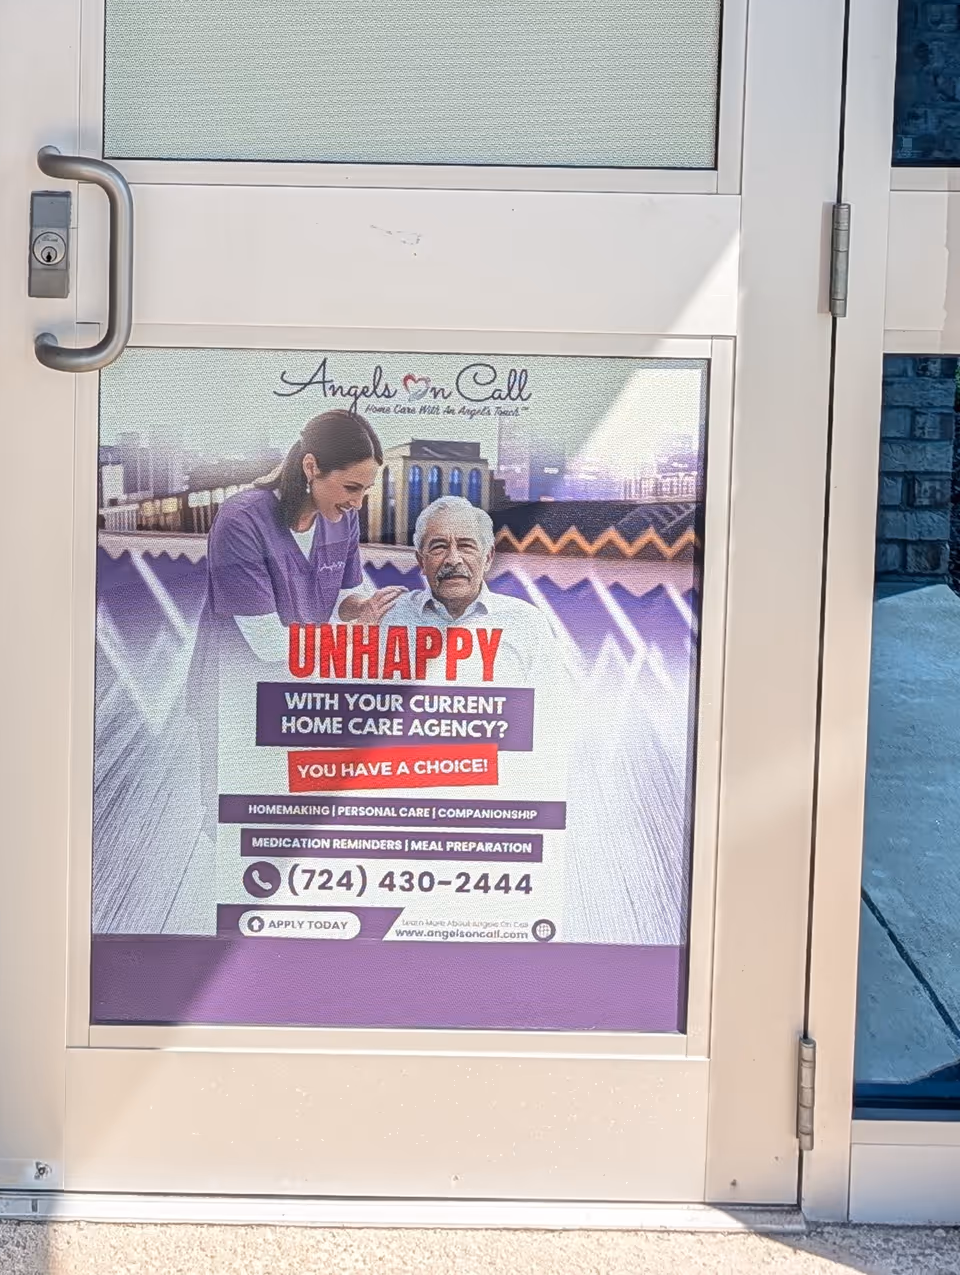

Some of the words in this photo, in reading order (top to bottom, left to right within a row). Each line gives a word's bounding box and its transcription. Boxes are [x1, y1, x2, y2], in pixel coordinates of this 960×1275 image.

[273, 358, 397, 416] Angels
[456, 364, 531, 402] Call
[289, 623, 503, 681] UNHAPPY
[285, 692, 339, 710] WITH
[345, 694, 404, 712] YOUR
[409, 695, 506, 714] CURRENT
[281, 716, 343, 734] HOME
[348, 718, 403, 735] CARE
[408, 719, 508, 738] AGENCY?
[297, 764, 337, 778] YOU
[341, 762, 392, 776] HAVE
[396, 762, 409, 775] A
[414, 759, 488, 774] CHOICE!
[248, 804, 330, 816] HOMEMAKING
[338, 806, 397, 818] PERSONAL
[399, 807, 430, 818] CARE
[438, 809, 537, 819] COMPANIONSHIP
[252, 837, 331, 849] MEDICATION
[333, 839, 402, 851] REMINDERS
[411, 840, 443, 851] MEAL
[446, 841, 532, 853] PREPARATION
[288, 863, 367, 897] (724)
[378, 870, 533, 894] 430-2444
[268, 920, 305, 929] APPLY
[308, 921, 348, 930] TODAY
[395, 929, 528, 940] www.angelsoncall.com
